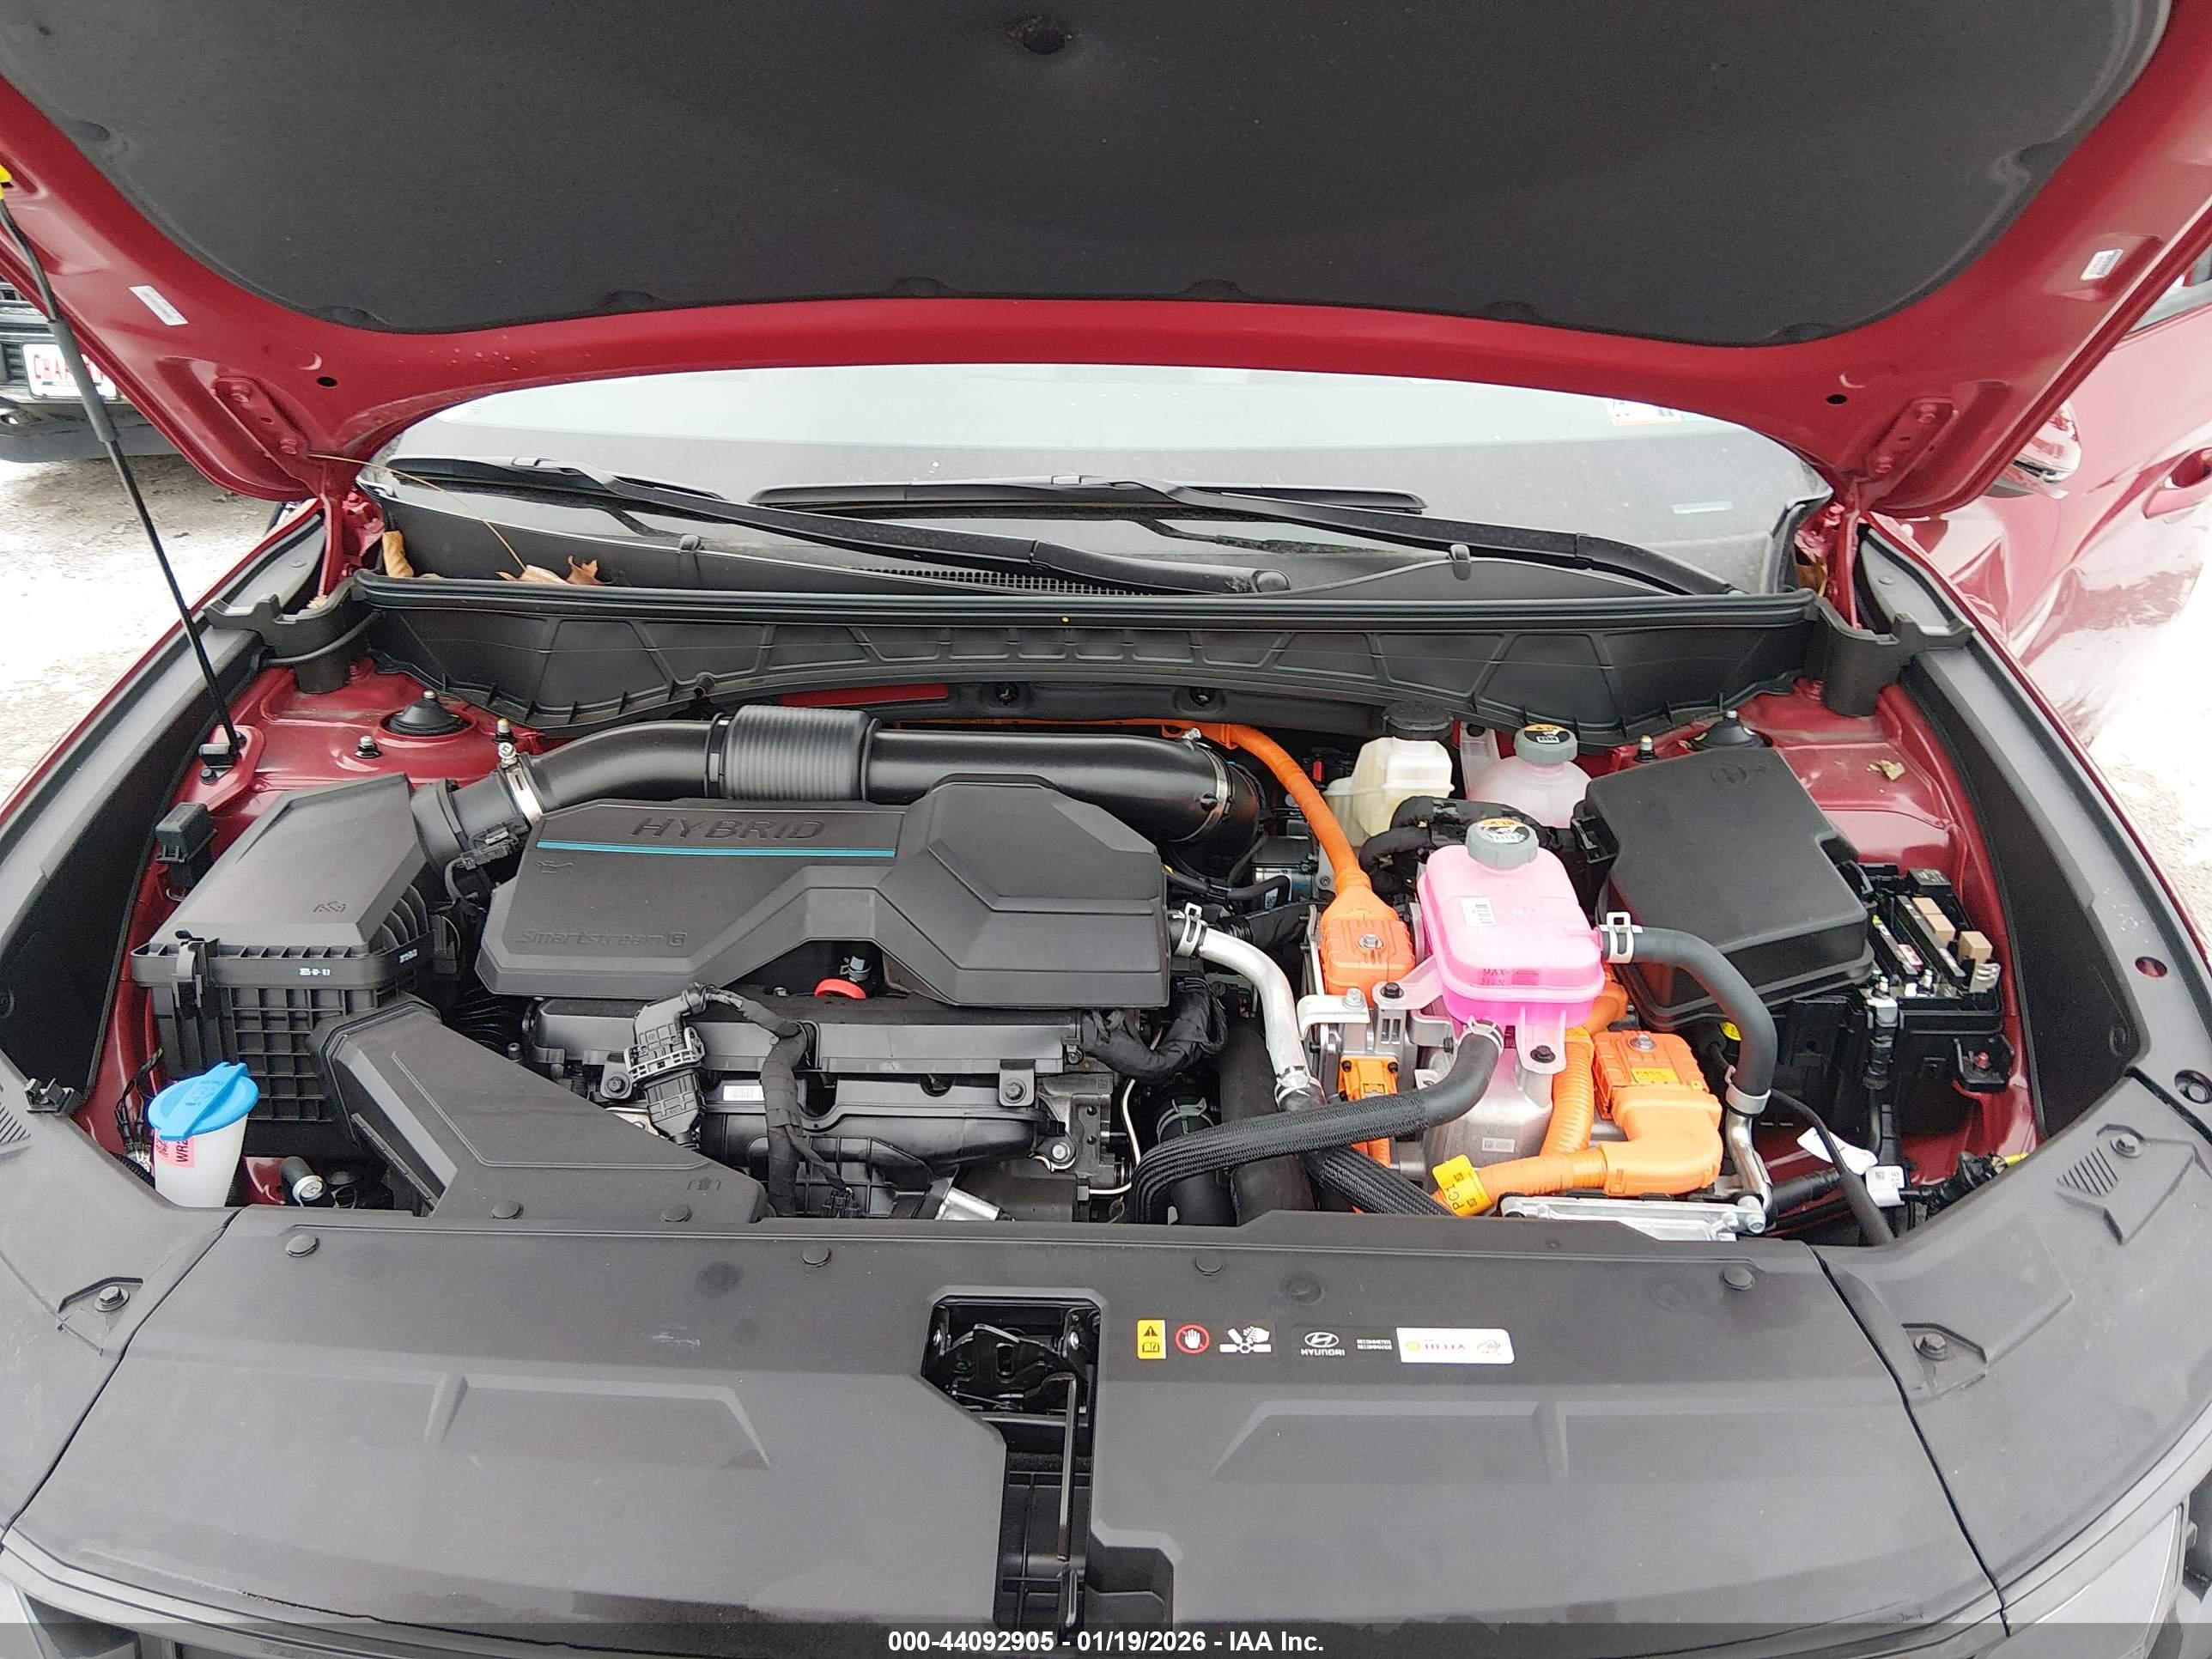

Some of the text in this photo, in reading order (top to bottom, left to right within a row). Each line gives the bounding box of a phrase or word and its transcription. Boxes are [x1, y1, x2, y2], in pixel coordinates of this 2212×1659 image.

[629, 817, 826, 840] HYBRID
[1483, 968, 1505, 976] MAX
[1300, 1348, 1346, 1357] HYUNDAI
